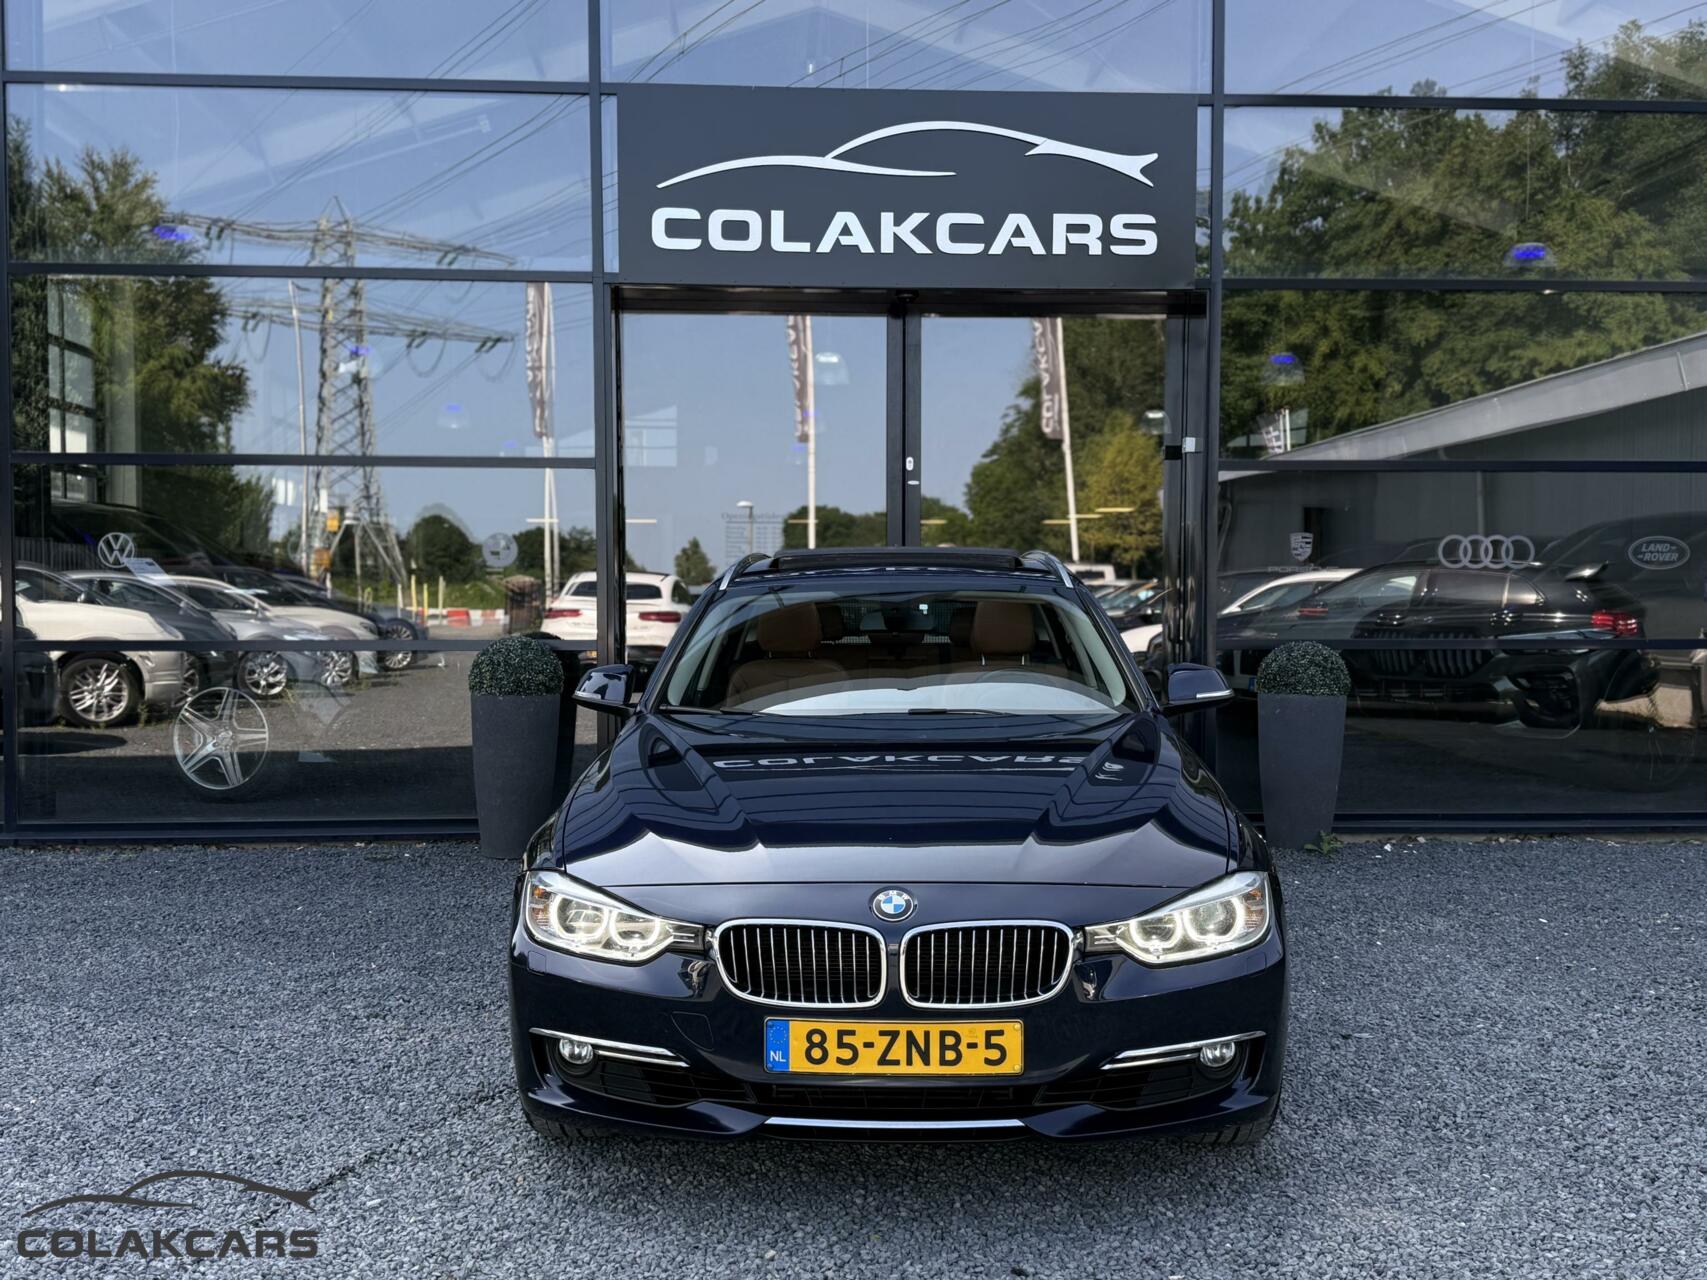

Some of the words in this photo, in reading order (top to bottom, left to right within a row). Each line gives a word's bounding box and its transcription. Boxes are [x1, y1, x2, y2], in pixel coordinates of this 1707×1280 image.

[651, 206, 1159, 257] COLAKCARS
[769, 1051, 787, 1063] NL
[804, 1028, 1008, 1067] 85-ZNB-5
